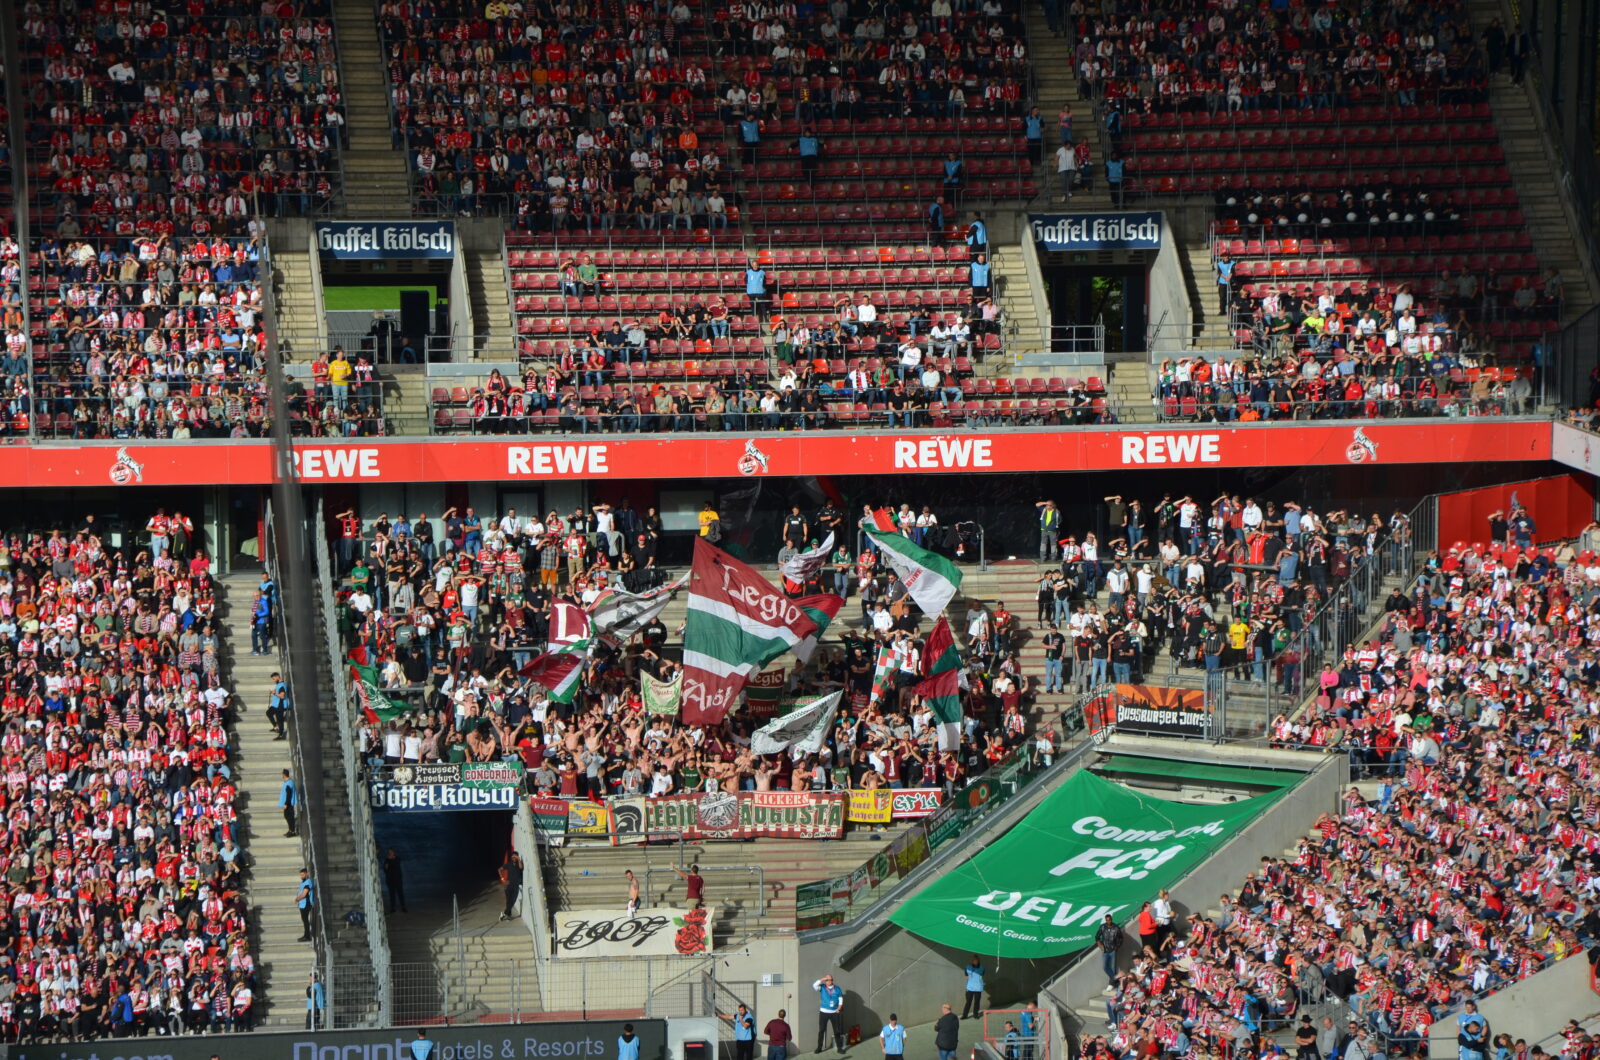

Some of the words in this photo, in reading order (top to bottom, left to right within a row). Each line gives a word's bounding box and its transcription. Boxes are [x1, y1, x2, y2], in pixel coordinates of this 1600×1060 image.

[318, 227, 380, 252] Gaffel
[383, 227, 452, 253] Kölsch
[1032, 217, 1089, 244] Gaffel
[1092, 217, 1159, 244] Kölsch
[277, 449, 380, 478] REWE
[507, 446, 608, 474] REWE
[894, 439, 993, 468] REWE
[1122, 435, 1221, 464] REWE
[722, 563, 802, 625] Legio
[751, 672, 783, 687] egio
[464, 768, 518, 781] CONCORDIA
[754, 792, 809, 806] KICKERS
[740, 803, 842, 826] AUGUSTA
[1072, 816, 1175, 842] Come
[1048, 844, 1186, 880] FC!
[973, 890, 1131, 927] DEVK
[557, 915, 671, 950] 1907
[955, 914, 999, 934] Gesagt.
[1003, 929, 1039, 942] Getan.
[501, 1040, 515, 1058] &
[524, 1037, 605, 1058] Resorts
